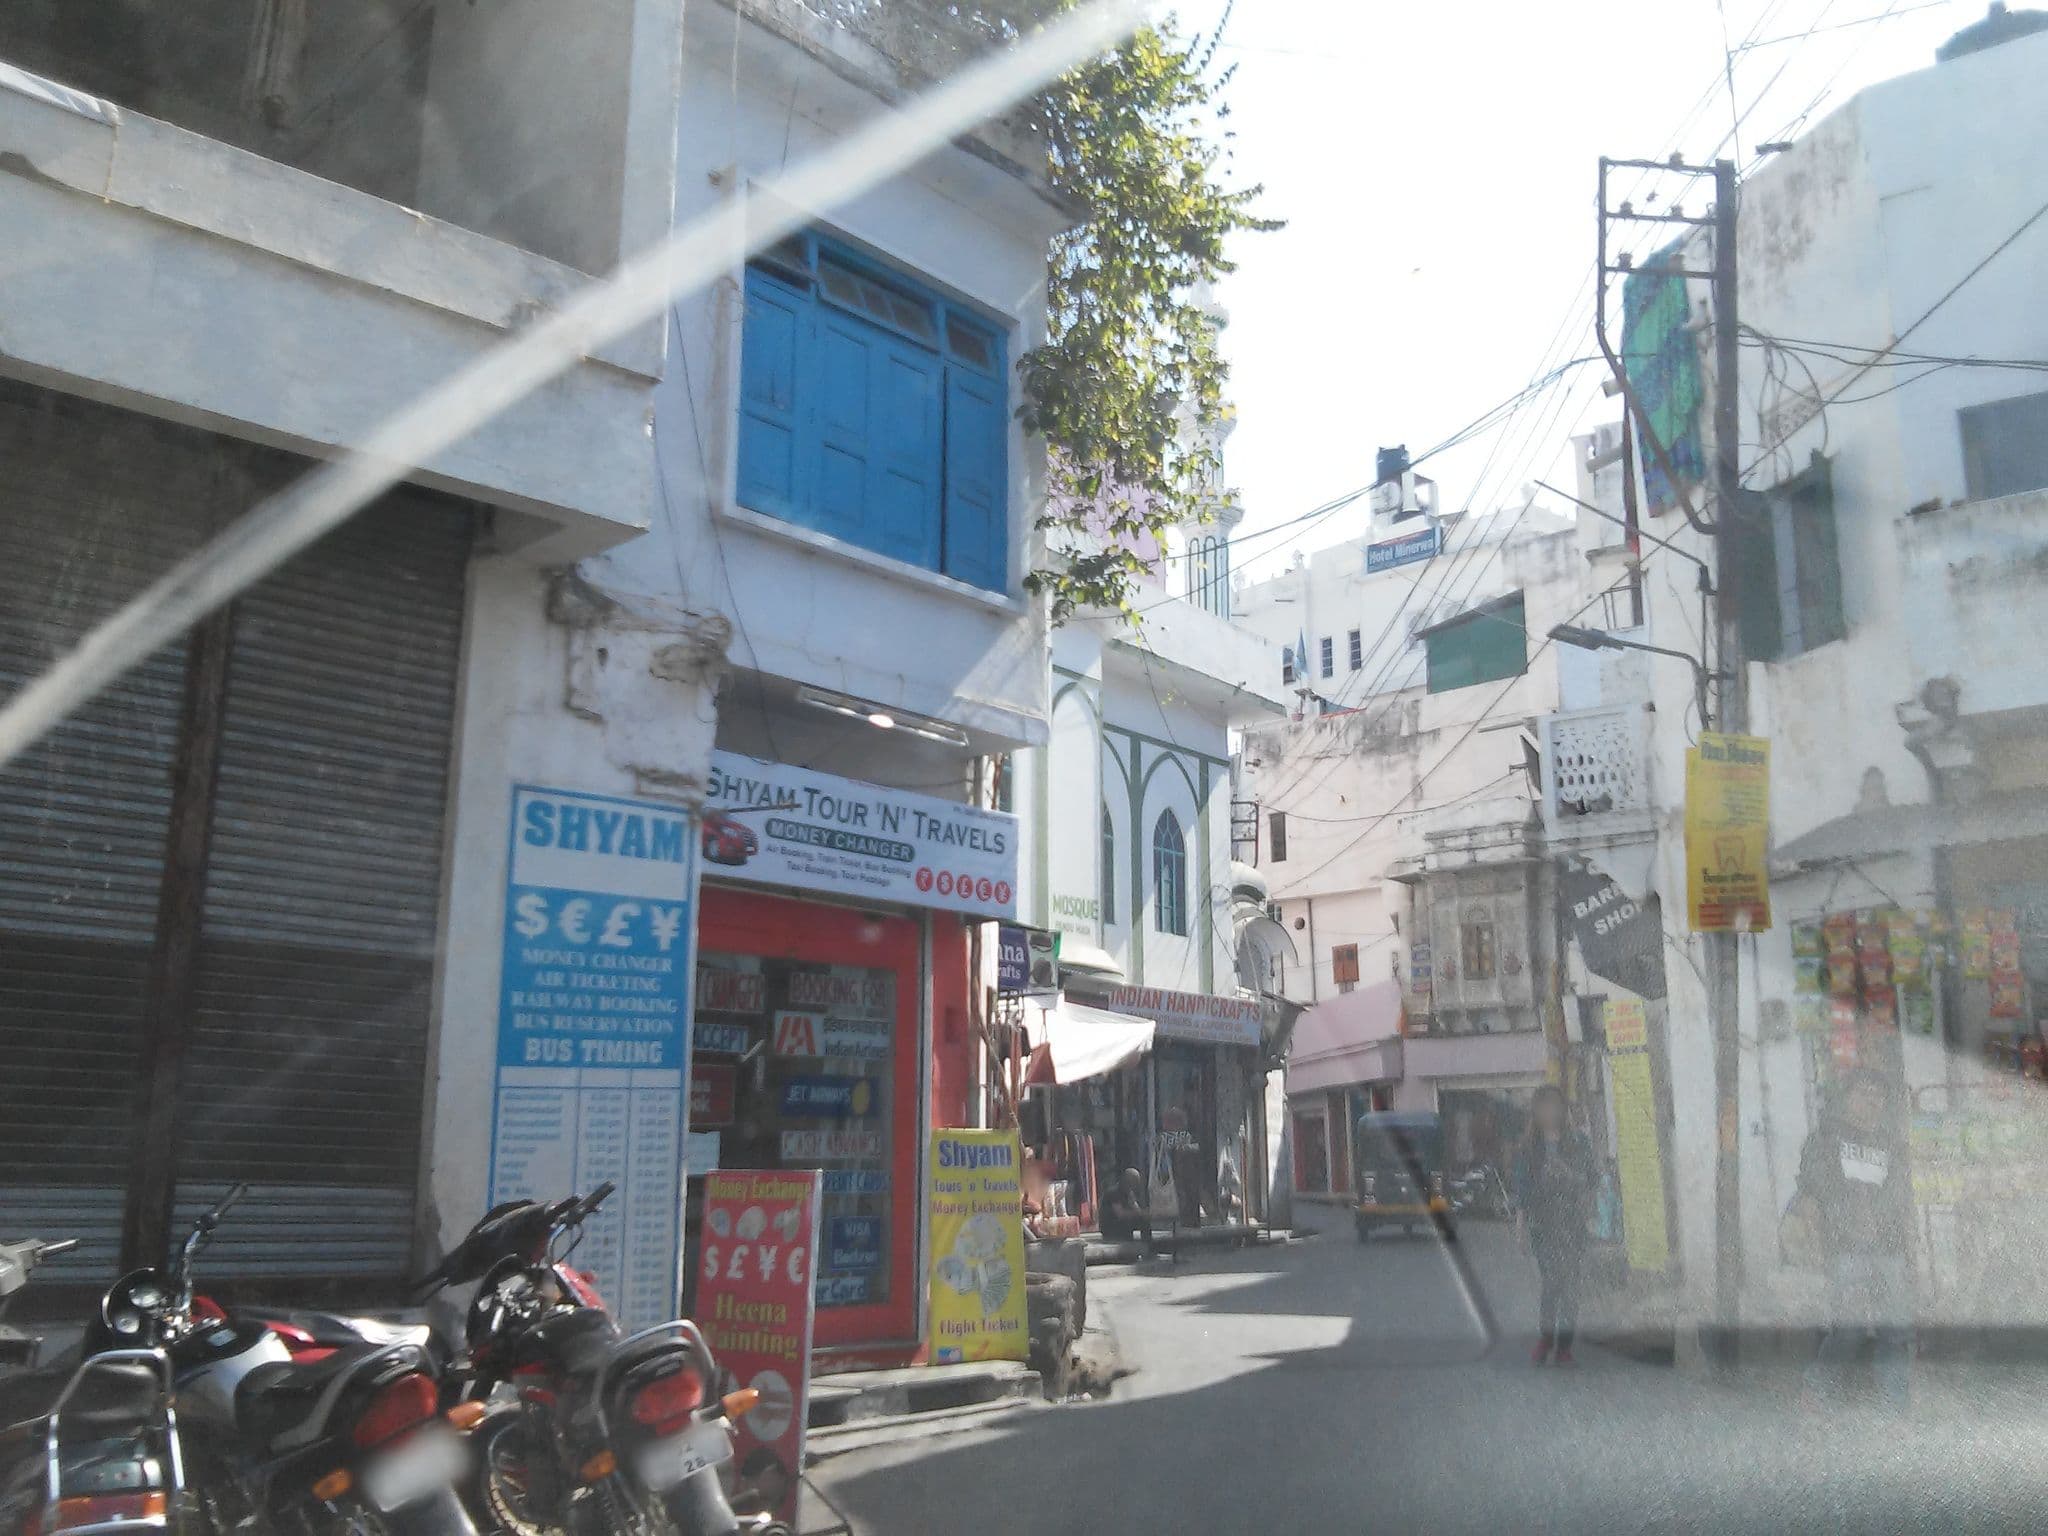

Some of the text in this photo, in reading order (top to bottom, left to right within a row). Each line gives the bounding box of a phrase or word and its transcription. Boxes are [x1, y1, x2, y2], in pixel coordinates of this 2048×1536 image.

[706, 767, 796, 812] SHYAM
[803, 787, 866, 827] TOUR
[914, 809, 1005, 855] TRAVELS
[524, 800, 686, 863] SHYAM
[771, 821, 910, 861] MONEY CHANGER
[514, 893, 683, 951] $ € £ ¥
[1053, 897, 1097, 919] MOSQUE
[592, 953, 672, 972] CHANGER
[1111, 986, 1161, 1010] INDIAN
[1167, 992, 1260, 1022] HANDICRAFTS
[525, 1037, 663, 1063] BUS TIMING
[938, 1139, 1012, 1168] Shyam
[715, 1293, 787, 1325] Heena
[940, 1320, 976, 1336] Flight
